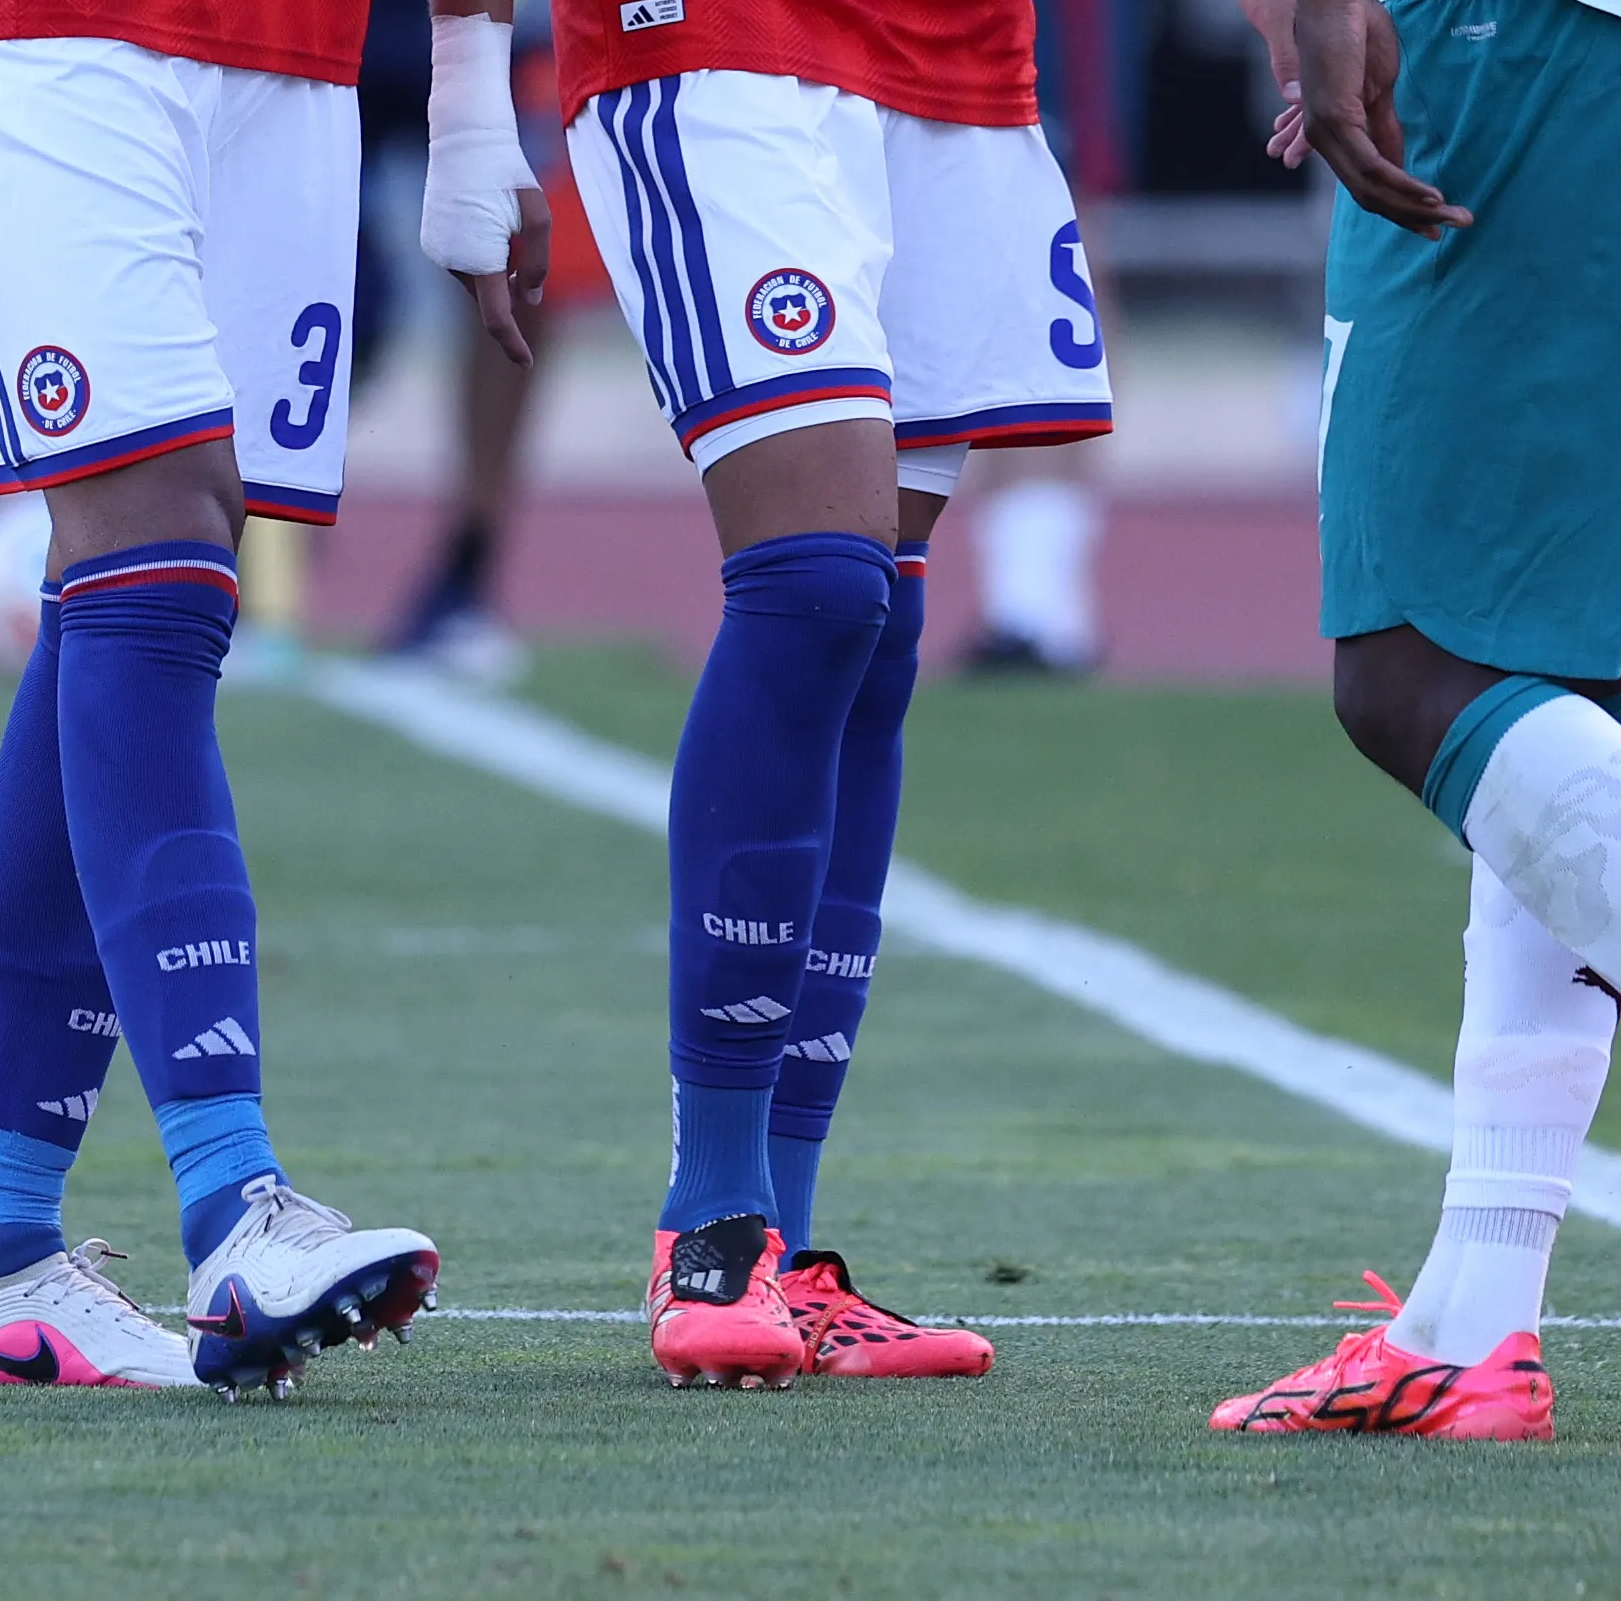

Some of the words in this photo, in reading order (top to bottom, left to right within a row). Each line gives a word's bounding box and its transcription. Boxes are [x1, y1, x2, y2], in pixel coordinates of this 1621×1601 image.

[752, 275, 785, 320] FEDERACION
[789, 274, 801, 285] DE
[803, 279, 828, 309] FUTBOL
[778, 338, 791, 349] DE
[795, 331, 819, 348] CHILE
[46, 351, 56, 362] DE
[58, 355, 82, 384] FUTBOL
[270, 302, 342, 450] 3
[44, 419, 54, 430] DE
[56, 409, 77, 429] CHILE
[702, 912, 794, 946] CHILE
[156, 939, 251, 972] CHILE
[67, 1008, 122, 1038] CHI
